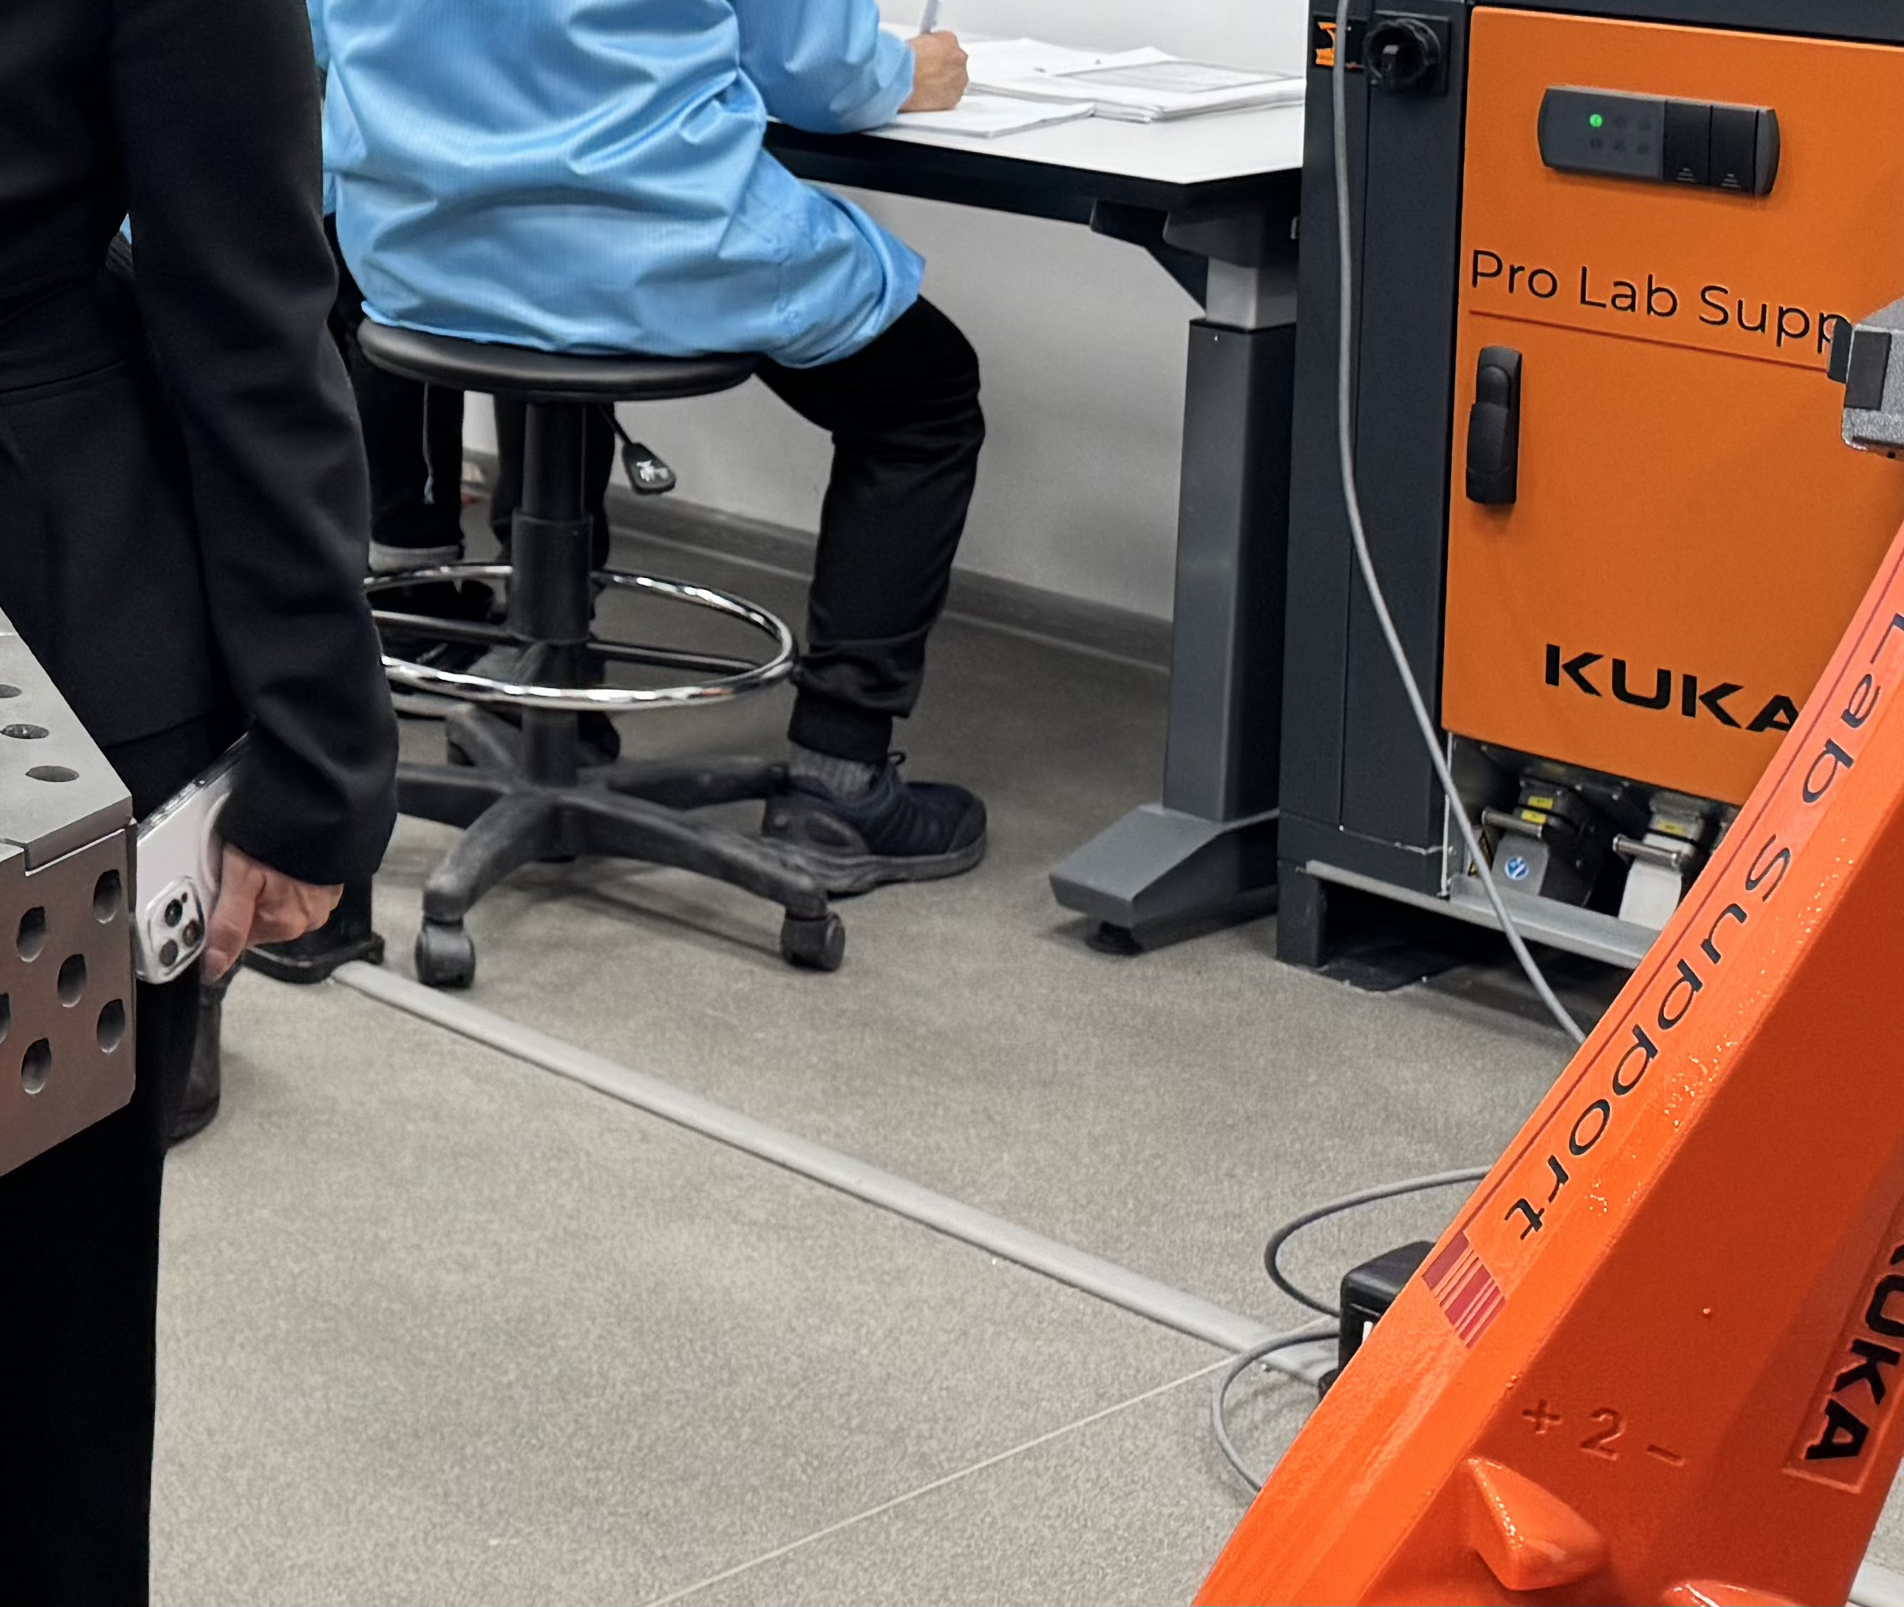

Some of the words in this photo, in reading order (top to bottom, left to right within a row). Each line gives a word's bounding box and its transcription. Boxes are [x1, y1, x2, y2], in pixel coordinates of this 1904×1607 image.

[1472, 249, 1558, 298] Pro
[1580, 266, 1678, 317] Lab
[1545, 643, 1799, 732] KUKA
[1503, 834, 1791, 1240] Support
[1804, 1244, 1904, 1460] UKA
